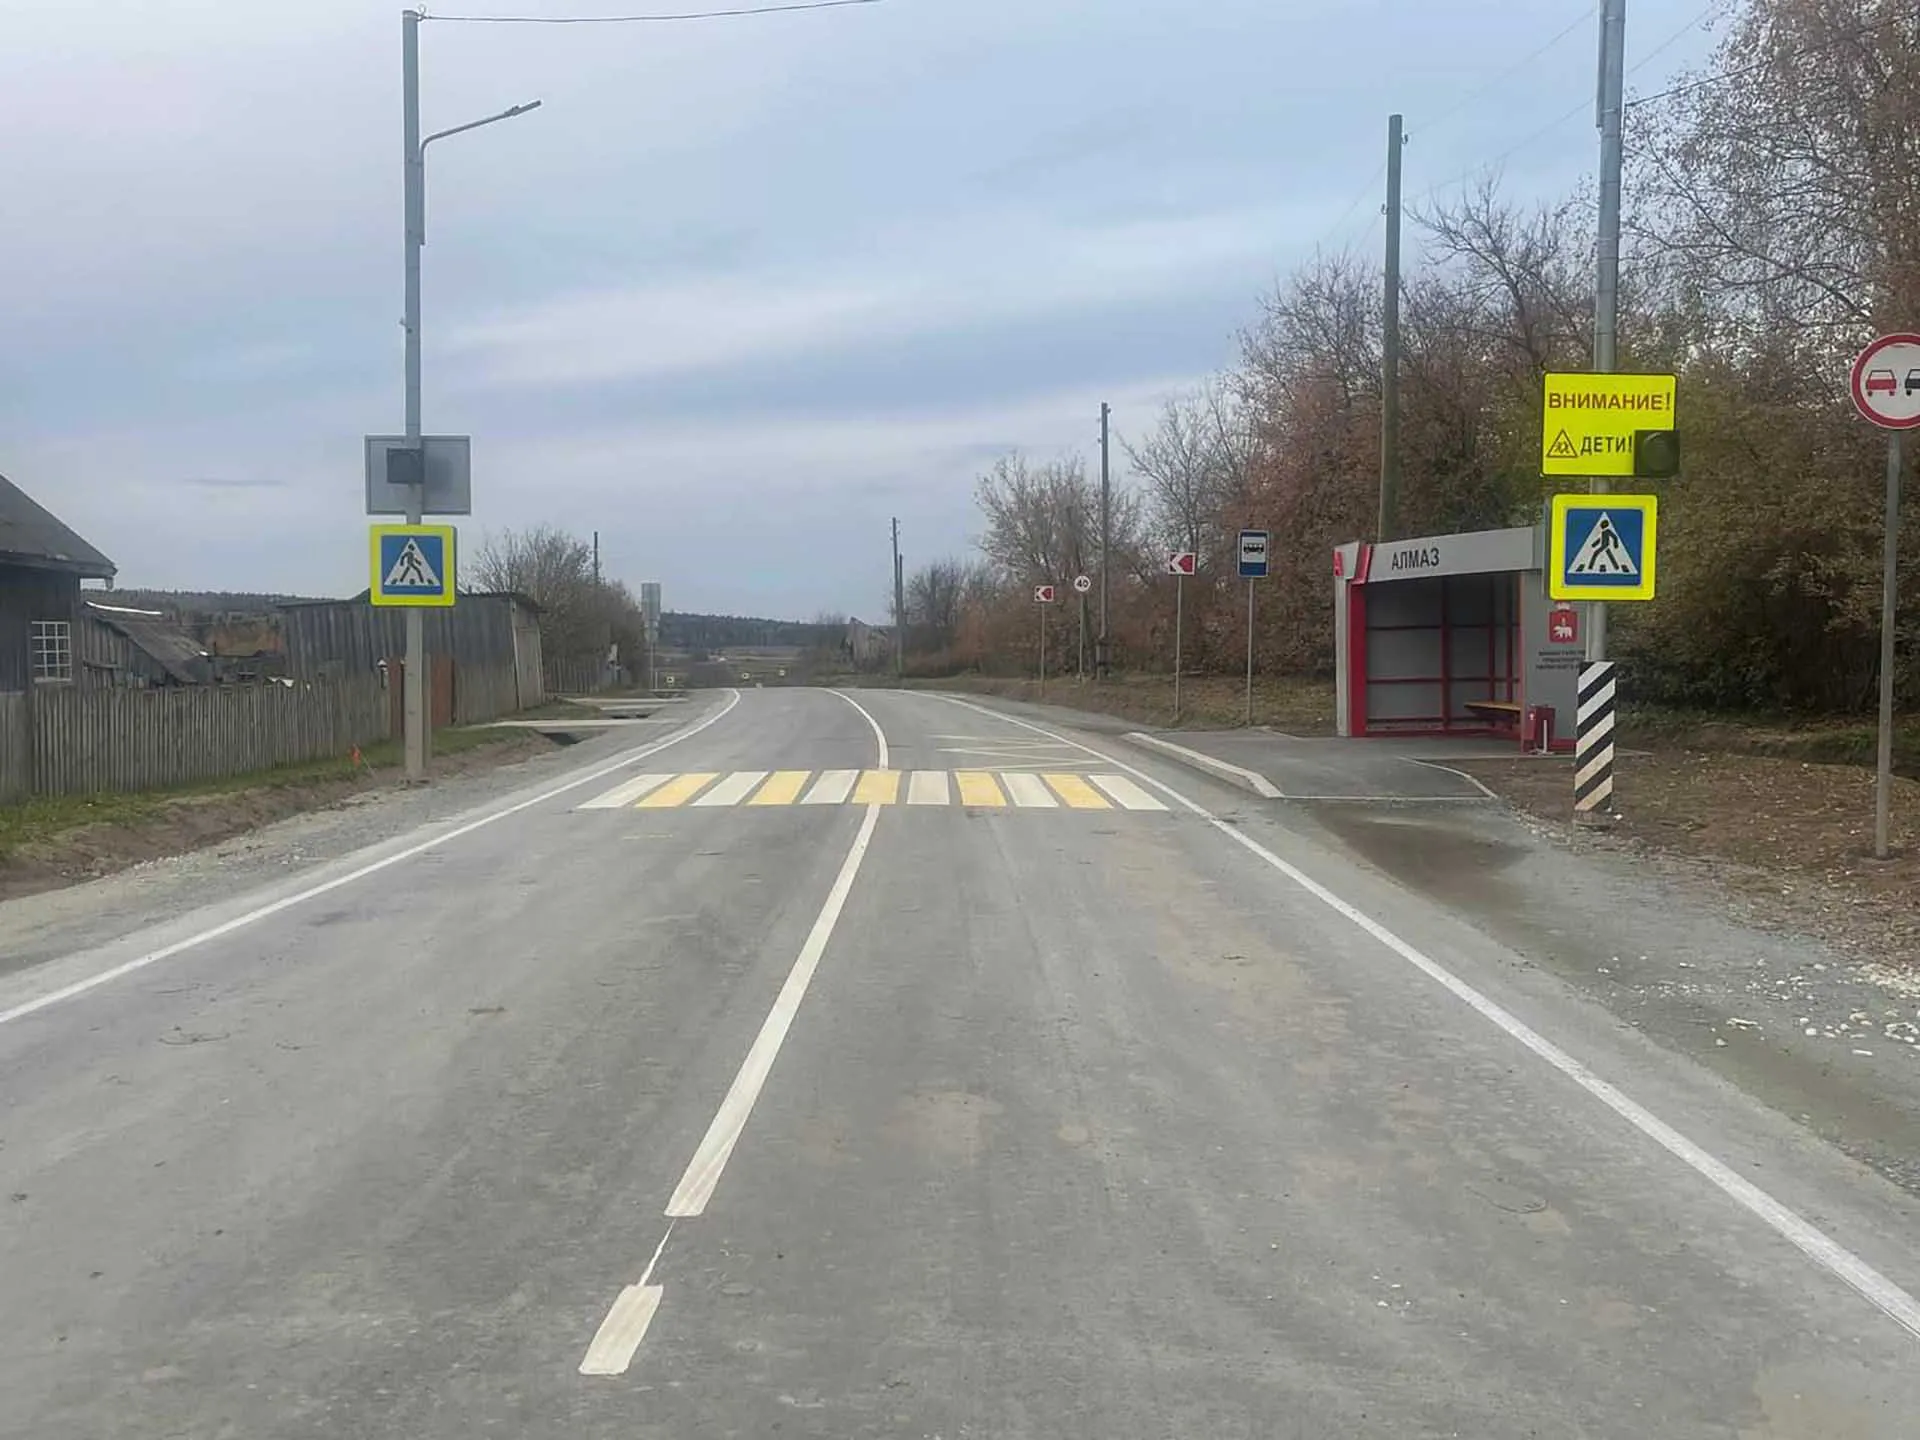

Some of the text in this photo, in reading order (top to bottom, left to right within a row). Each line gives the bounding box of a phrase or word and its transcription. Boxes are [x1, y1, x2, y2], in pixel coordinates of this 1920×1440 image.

[1549, 392, 1671, 410] ВНИМАНИЕ!
[1580, 435, 1633, 456] ДЕТИ!
[1391, 547, 1440, 570] АЛМАЗ
[1076, 579, 1089, 588] 40
